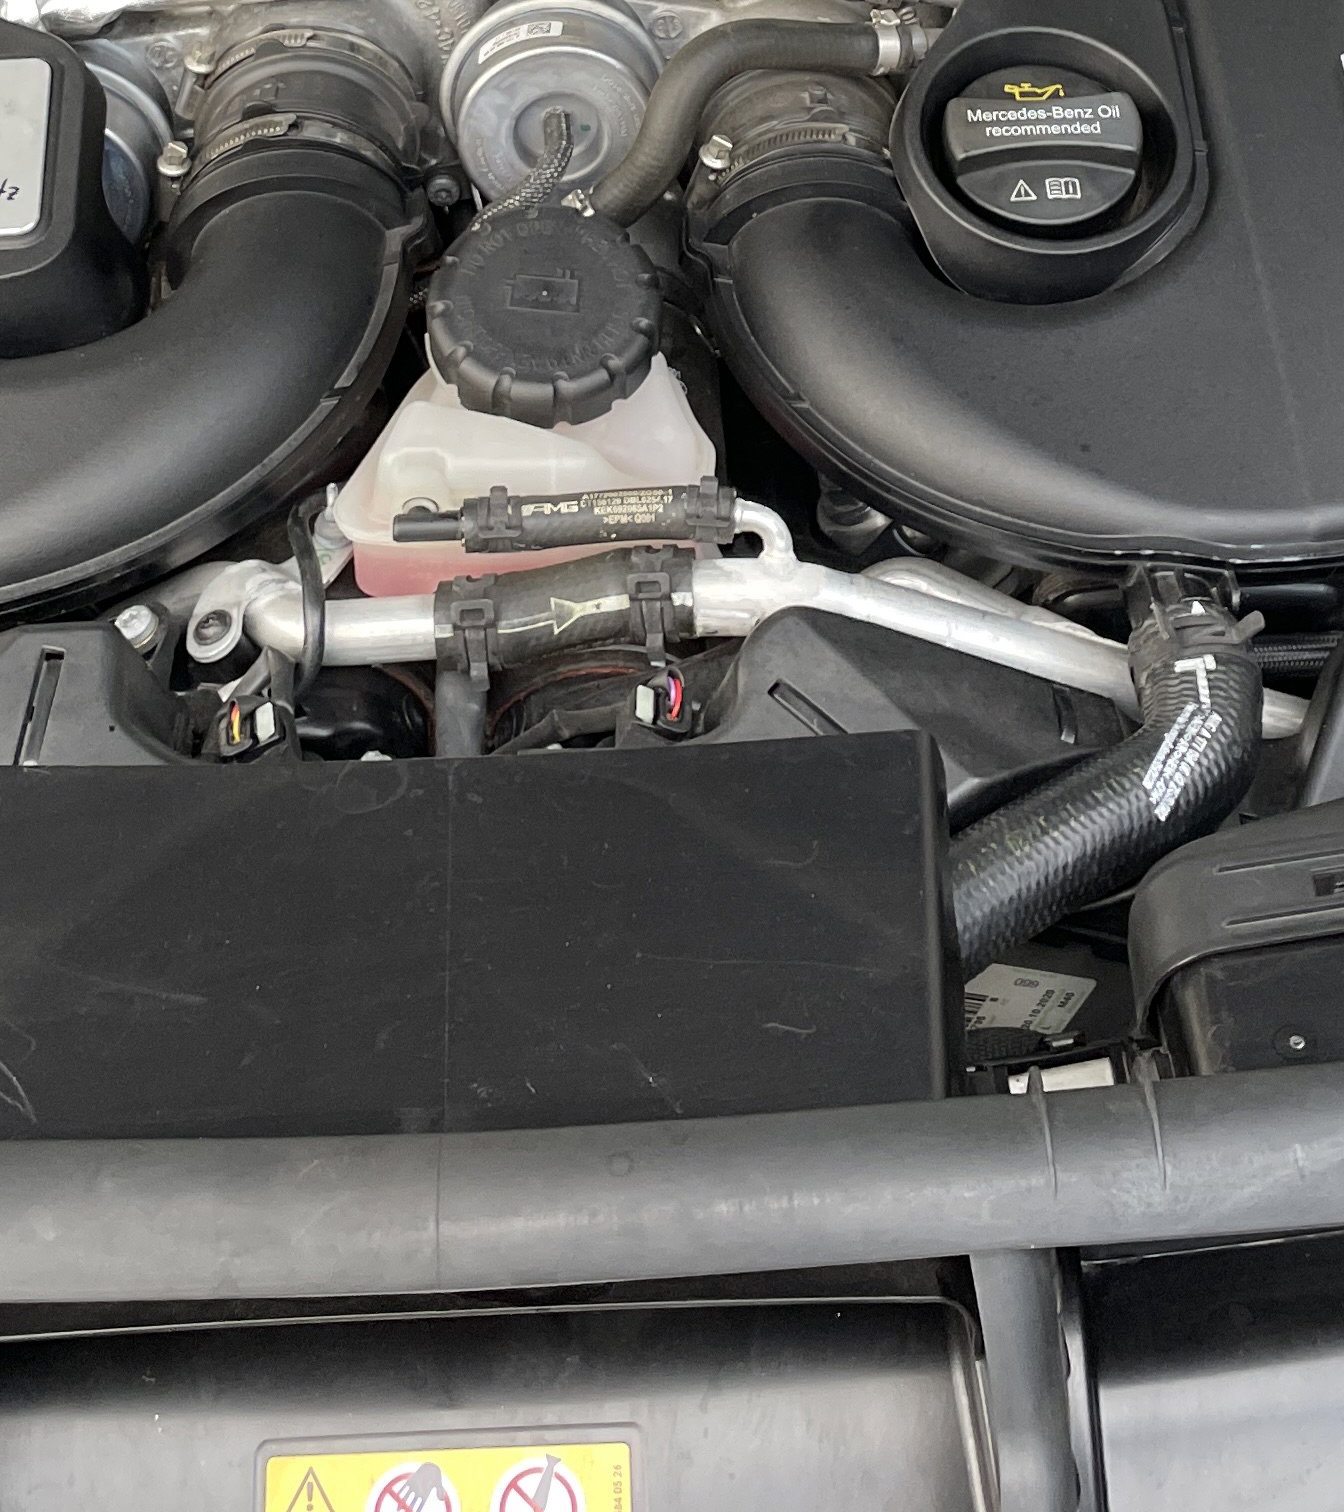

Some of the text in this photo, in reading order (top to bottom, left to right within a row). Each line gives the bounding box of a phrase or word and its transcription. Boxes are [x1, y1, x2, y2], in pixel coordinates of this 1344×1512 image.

[966, 104, 1121, 122] Mercedes-Benz Oil
[985, 121, 1102, 137] recommended
[533, 501, 579, 515] AMG
